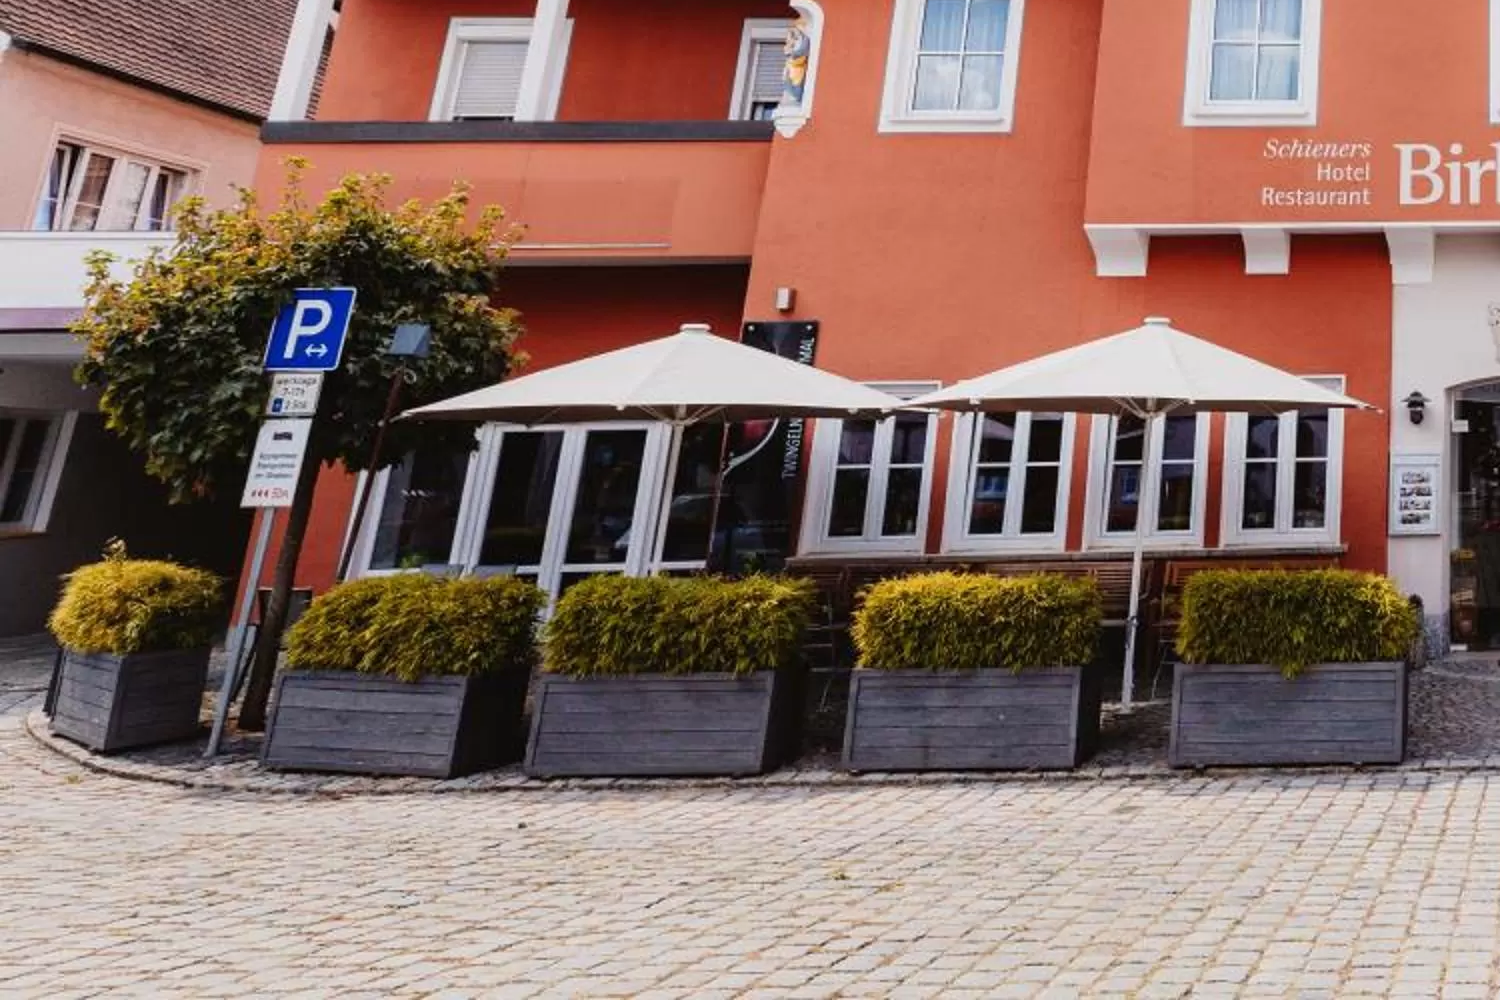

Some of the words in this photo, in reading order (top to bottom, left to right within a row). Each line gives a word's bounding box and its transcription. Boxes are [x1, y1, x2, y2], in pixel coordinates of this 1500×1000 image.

[1263, 137, 1372, 158] Schieners
[1316, 161, 1371, 182] Hotel
[1261, 186, 1372, 206] Restaurant
[283, 299, 332, 359] P
